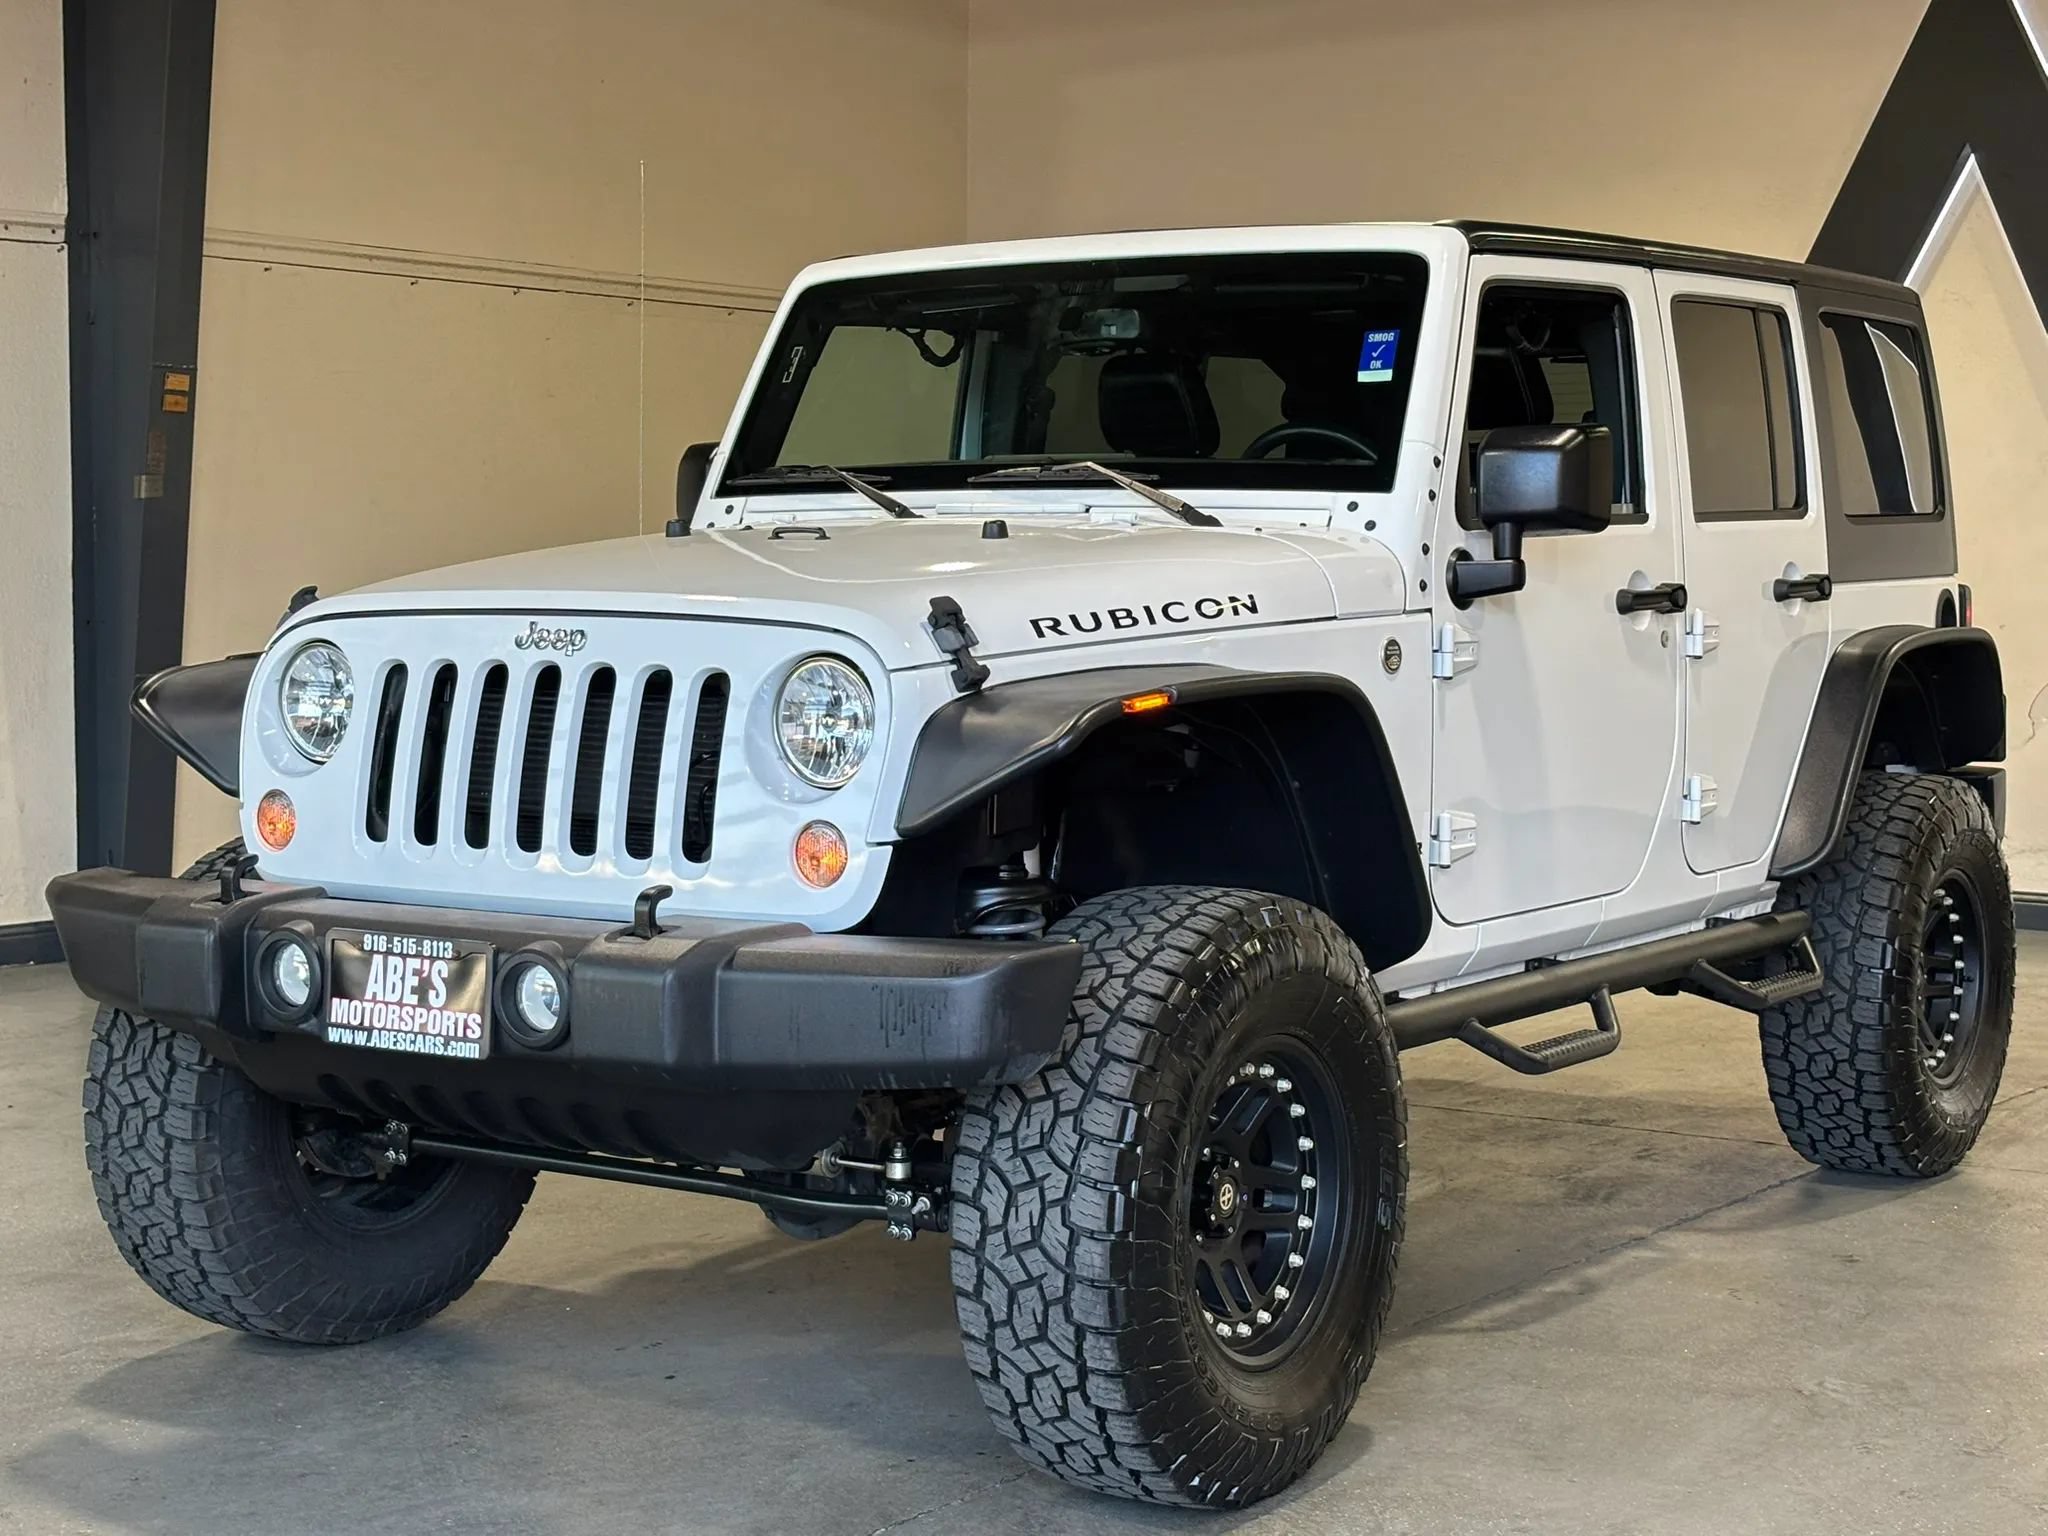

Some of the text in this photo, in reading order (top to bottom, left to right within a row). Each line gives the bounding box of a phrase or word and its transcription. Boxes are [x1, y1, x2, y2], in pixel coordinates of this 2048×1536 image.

[1368, 332, 1395, 342] SMOG
[1370, 360, 1383, 369] OK
[1029, 594, 1259, 639] RUBICON
[514, 621, 588, 657] Jeep
[363, 934, 454, 958] 916-515-8113
[364, 954, 449, 1008] ABE'S
[330, 997, 482, 1039] MOTORSPORTS
